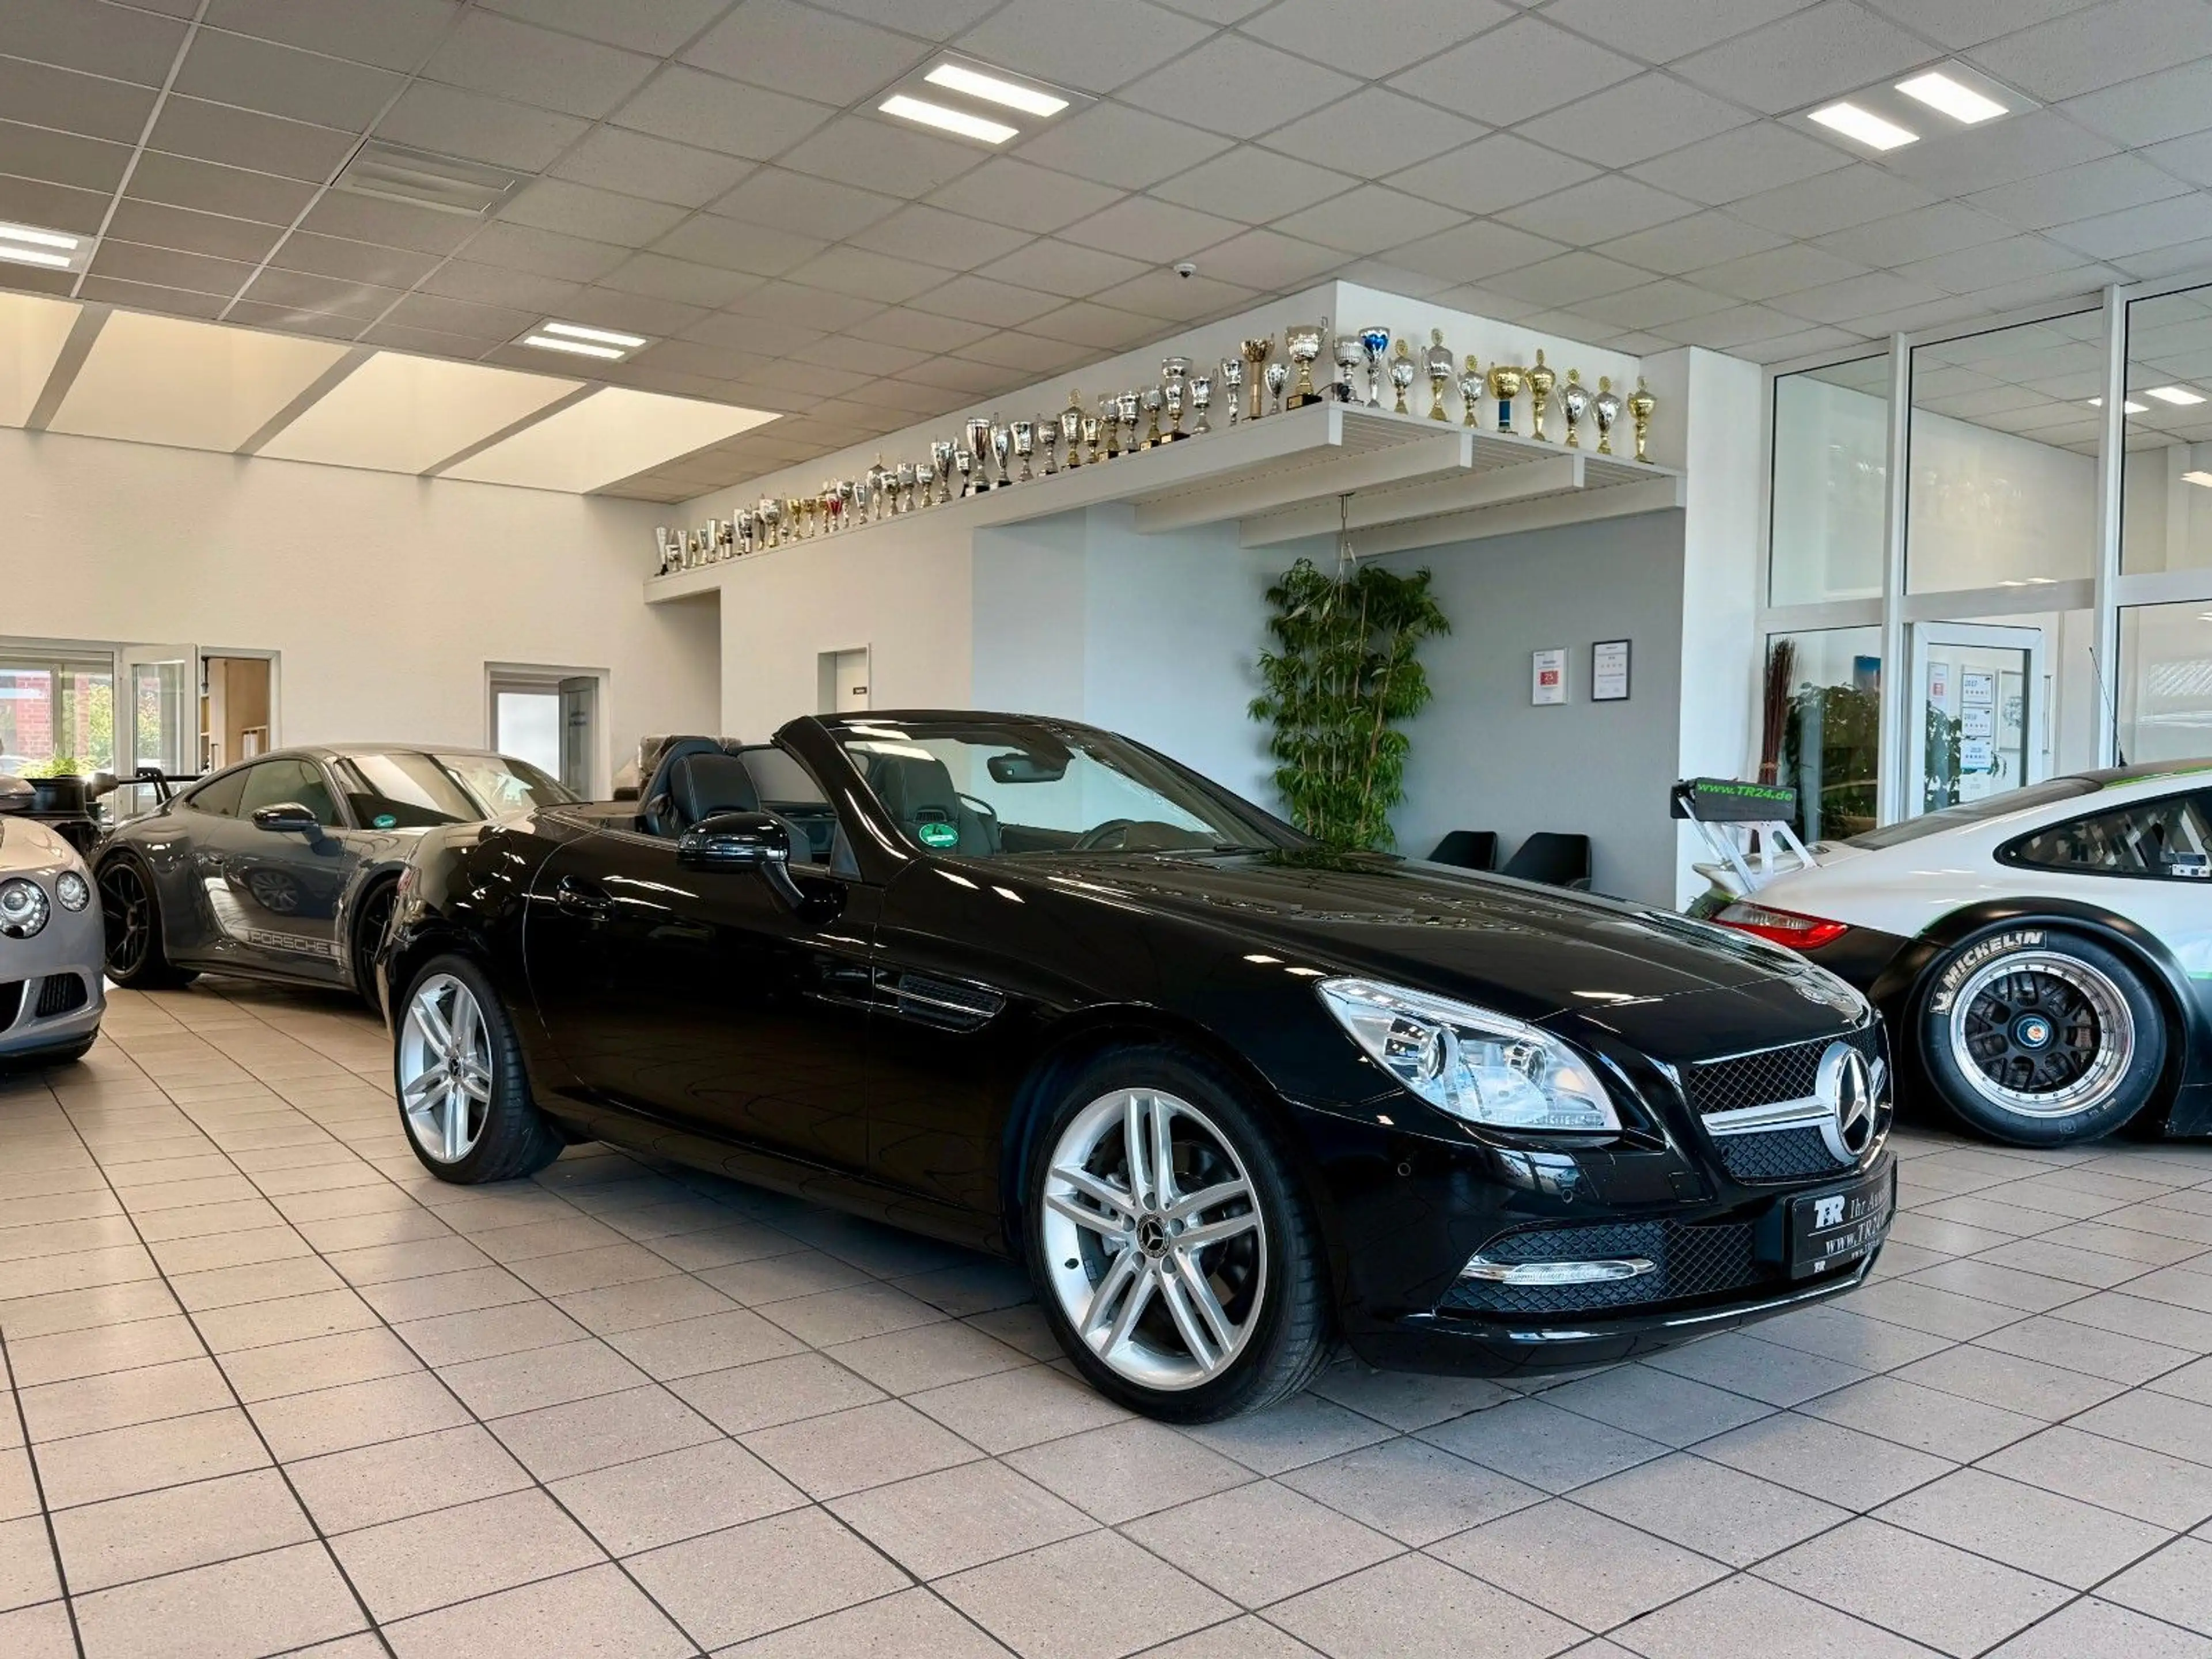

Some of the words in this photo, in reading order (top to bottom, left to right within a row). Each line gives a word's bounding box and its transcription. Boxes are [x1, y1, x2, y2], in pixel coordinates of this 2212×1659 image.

[1697, 783, 1793, 801] www.TR24.de
[250, 931, 329, 955] PORSCHE
[1942, 931, 2043, 990] MICHELIN
[1813, 1194, 1845, 1228] TR
